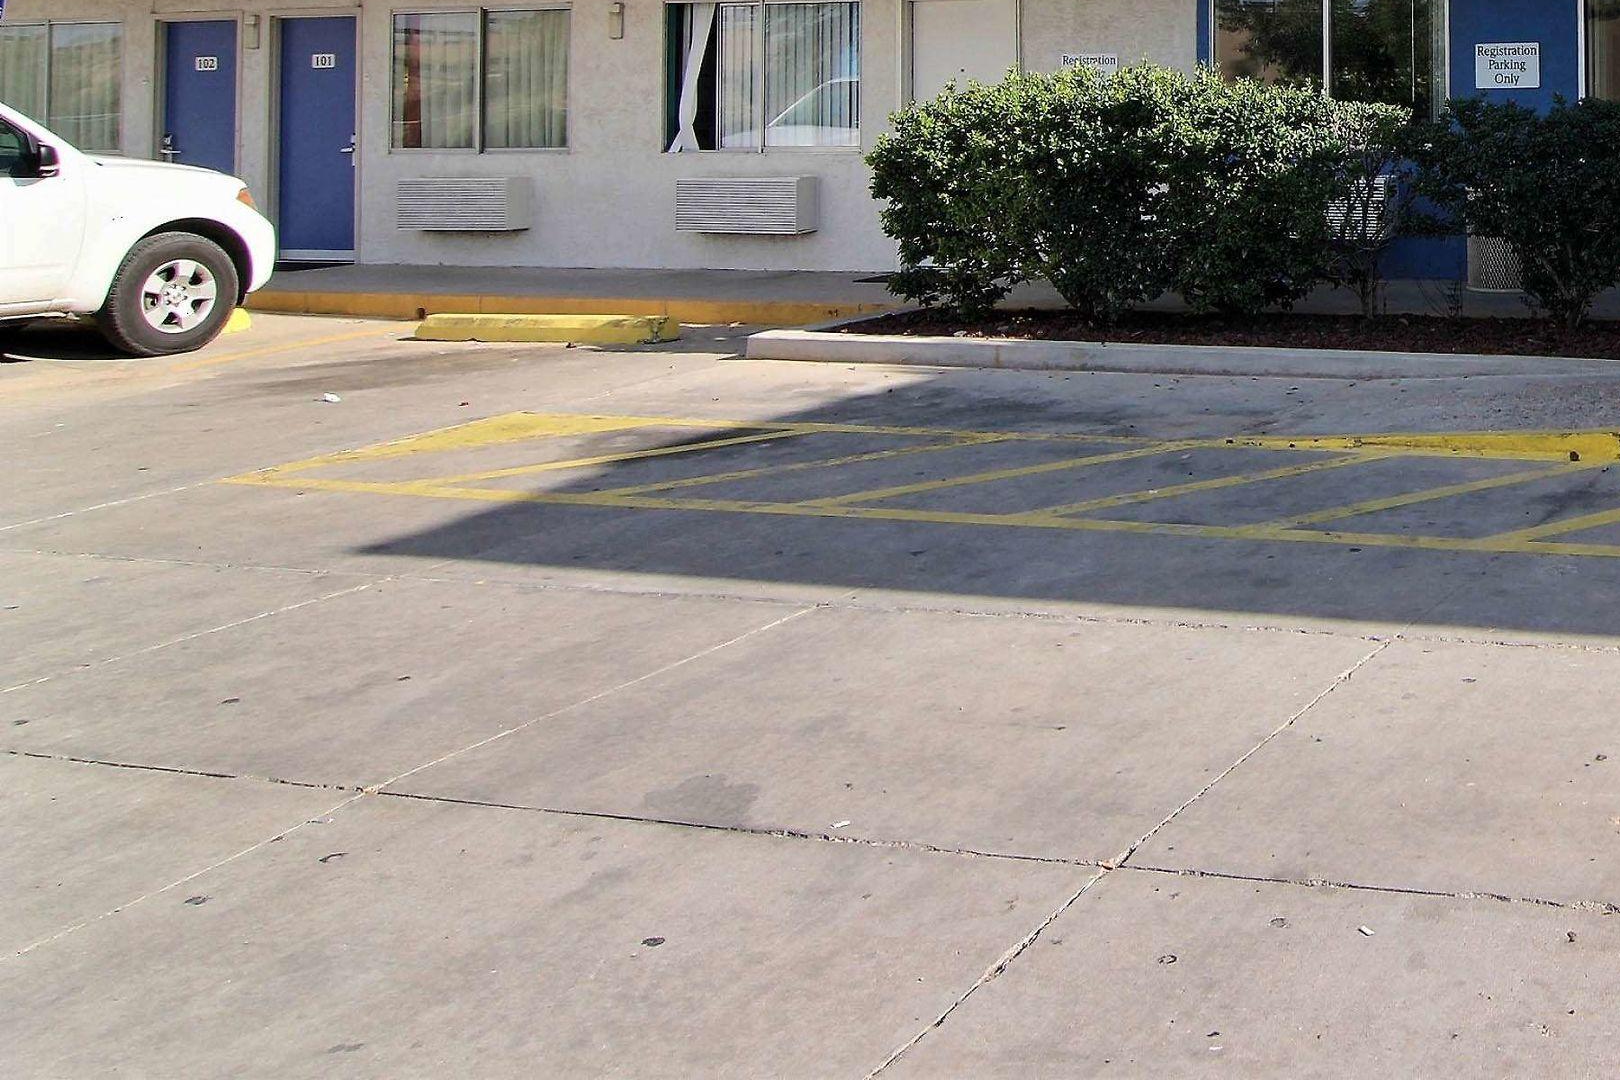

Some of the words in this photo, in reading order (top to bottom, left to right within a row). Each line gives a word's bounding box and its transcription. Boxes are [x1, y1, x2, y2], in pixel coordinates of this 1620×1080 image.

[1477, 45, 1537, 58] Registration
[198, 58, 215, 69] 102
[315, 56, 333, 66] 101
[1488, 60, 1526, 72] Parking
[1494, 73, 1520, 86] Only
